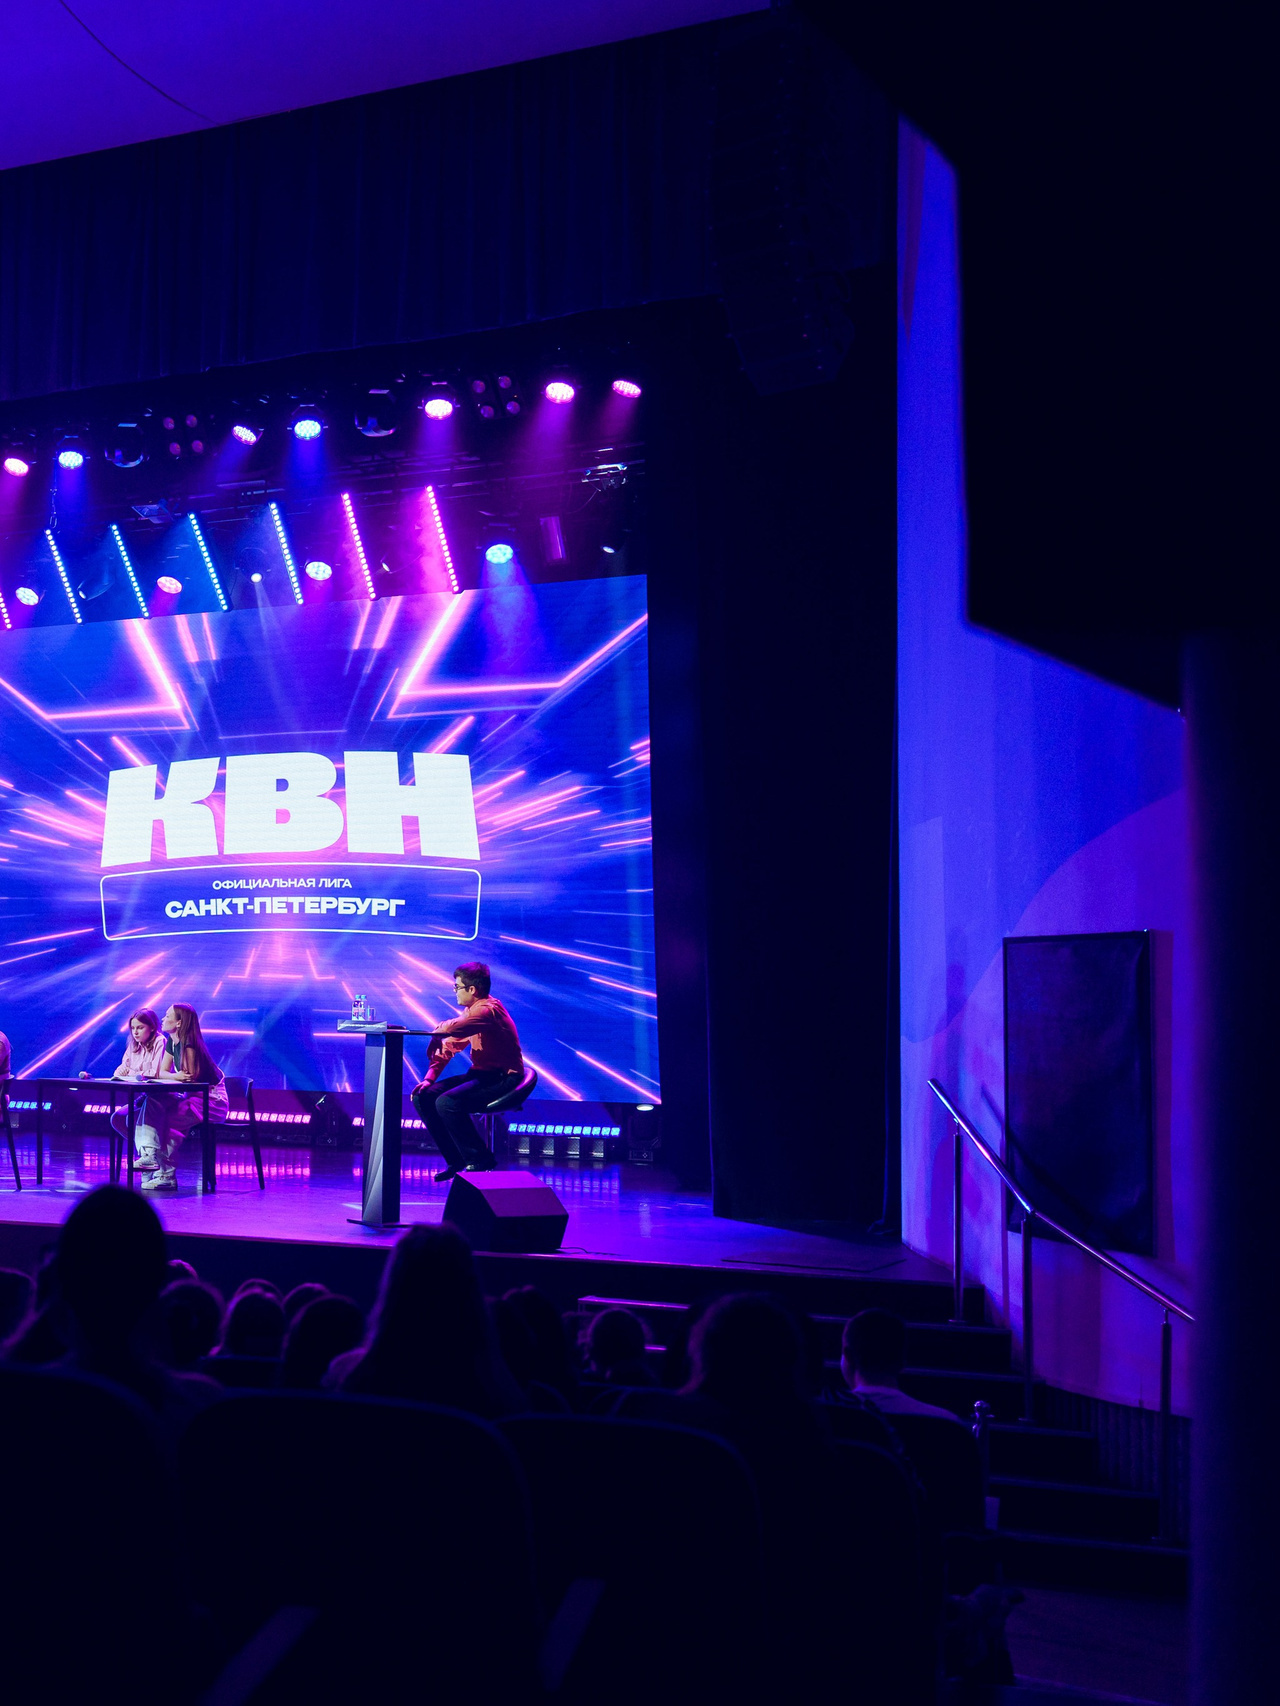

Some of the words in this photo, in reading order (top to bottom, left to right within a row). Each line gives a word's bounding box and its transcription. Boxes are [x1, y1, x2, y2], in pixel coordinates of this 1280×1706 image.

[100, 751, 481, 868] КВН
[212, 878, 316, 890] ОФИЦИАЛЬНАЯ
[318, 878, 352, 889] ЛИГА
[165, 896, 405, 918] САНКТ-ПЕТЕРБУРГ
